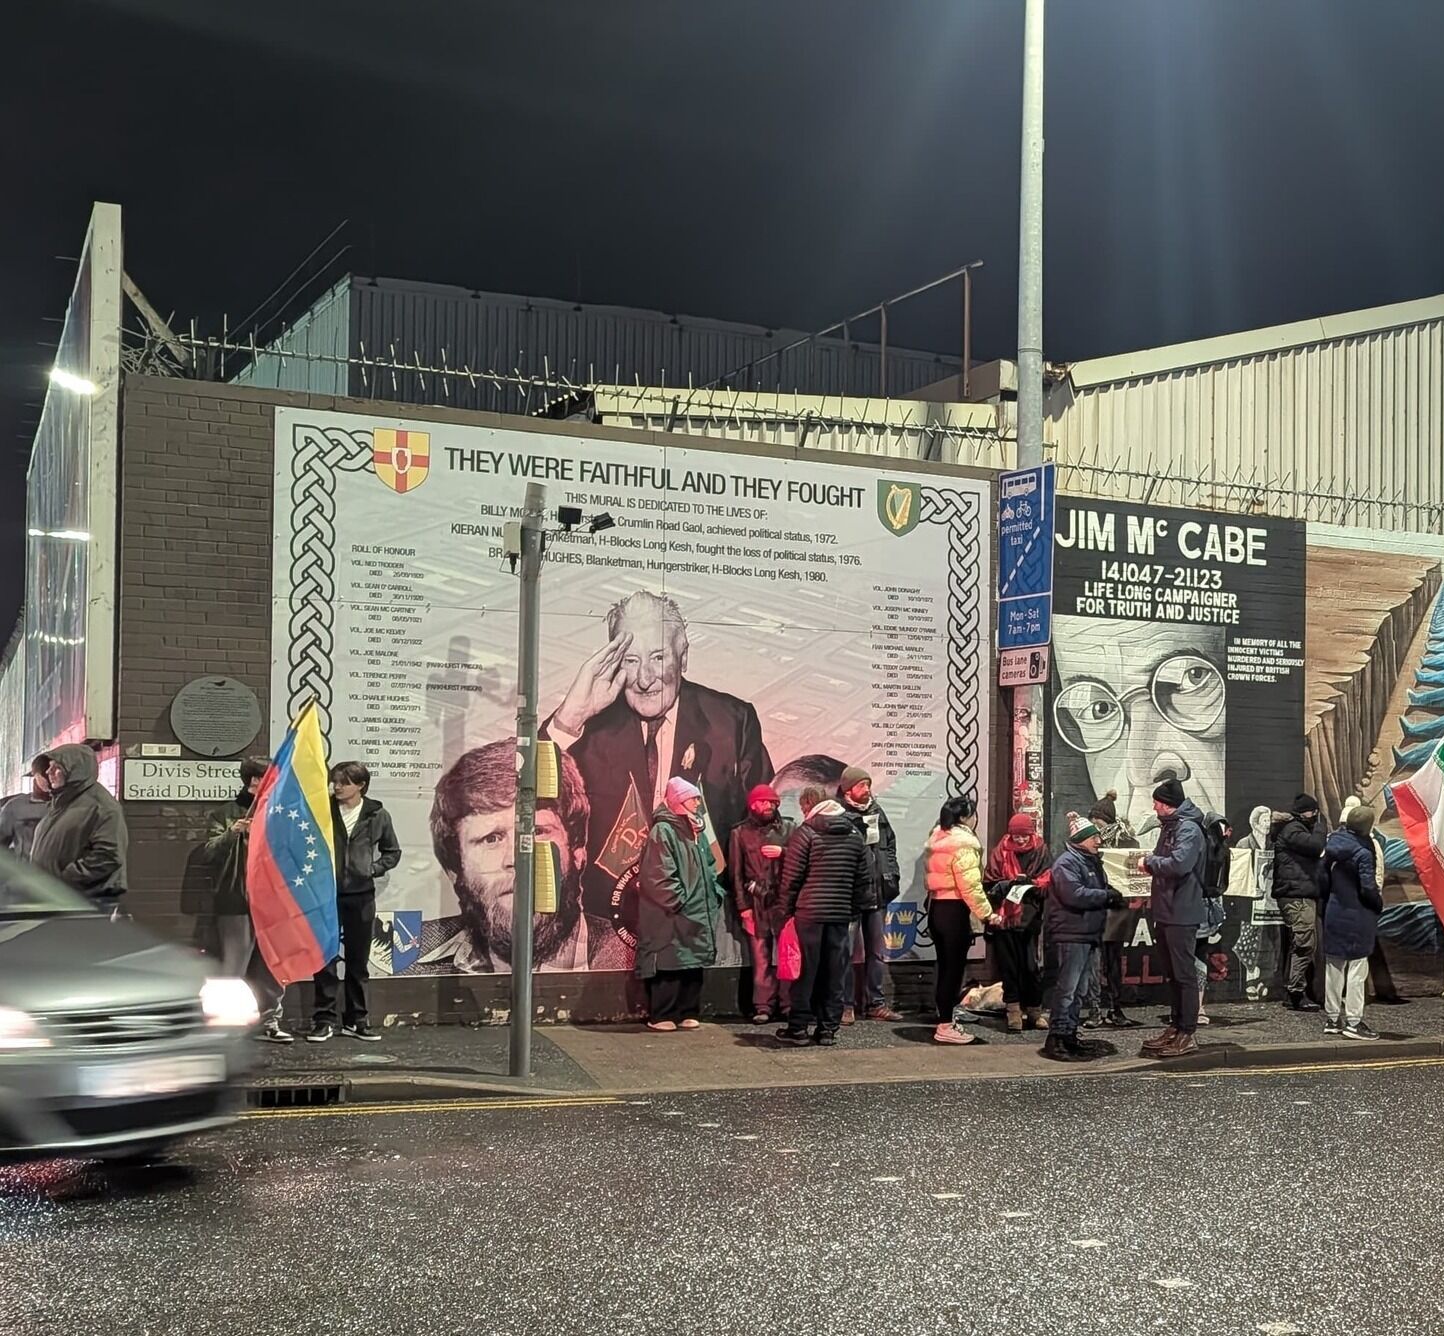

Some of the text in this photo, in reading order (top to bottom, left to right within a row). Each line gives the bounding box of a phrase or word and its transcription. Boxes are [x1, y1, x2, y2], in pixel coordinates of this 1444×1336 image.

[444, 447, 865, 508] THEY WERE FAITHFUL AND THEY FOUGHT
[565, 492, 768, 520] THIS MURAL IS DEDICATED TO THE LIVES OF:
[481, 504, 508, 516] BILLY
[618, 517, 654, 529] Crumlin
[656, 520, 680, 531] Road
[682, 522, 705, 534] Gaol,
[706, 524, 747, 537] achieved
[749, 527, 782, 540] political
[784, 530, 812, 544] status,
[815, 534, 838, 545] 1972.
[1002, 520, 1033, 536] permitted
[451, 524, 488, 537] KIERAN
[546, 532, 597, 546] anketman,
[600, 535, 641, 548] H-Blocks
[644, 537, 666, 552] Long
[669, 541, 694, 554] Kesh,
[696, 544, 724, 556] fought
[726, 544, 742, 556] the
[744, 546, 761, 557] loss
[762, 548, 773, 559] of
[774, 548, 807, 562] political
[809, 552, 836, 565] status,
[839, 555, 862, 566] 1976.
[1010, 534, 1023, 546] taxi
[1055, 509, 1267, 566] JIM Mc CABE
[352, 544, 416, 556] ROLL OF HONOUR
[586, 554, 645, 569] Blanketman,
[647, 558, 711, 575] Hungerstriker,
[712, 565, 753, 577] H-Blocks
[754, 567, 776, 581] Long
[778, 569, 802, 582] Kesh,
[804, 572, 828, 582] 1980.
[1084, 581, 1238, 608] LIFE LONG CAMPAIGNER
[1010, 610, 1040, 622] Mon-Sat
[1076, 597, 1240, 625] FOR TRUTH AND JUSTICE
[1008, 622, 1040, 636] 7am-7pm
[1234, 638, 1302, 649] IN MEMORY OF ALL THE
[1228, 647, 1284, 657] INNOCENT VICTIMS
[1002, 656, 1028, 667] Bus lane
[1228, 656, 1305, 667] MURDERED AND SERIOUSLY
[1002, 669, 1026, 680] cameras
[1228, 664, 1290, 675] INJURED BY BRITISH
[1228, 673, 1277, 682] CROWN FORCES.
[142, 763, 241, 778] Divis Stree
[128, 784, 242, 798] Sráid Dhuibhi
[616, 870, 633, 890] WHAT
[611, 890, 622, 906] FOR
[618, 926, 637, 947] UNBO
